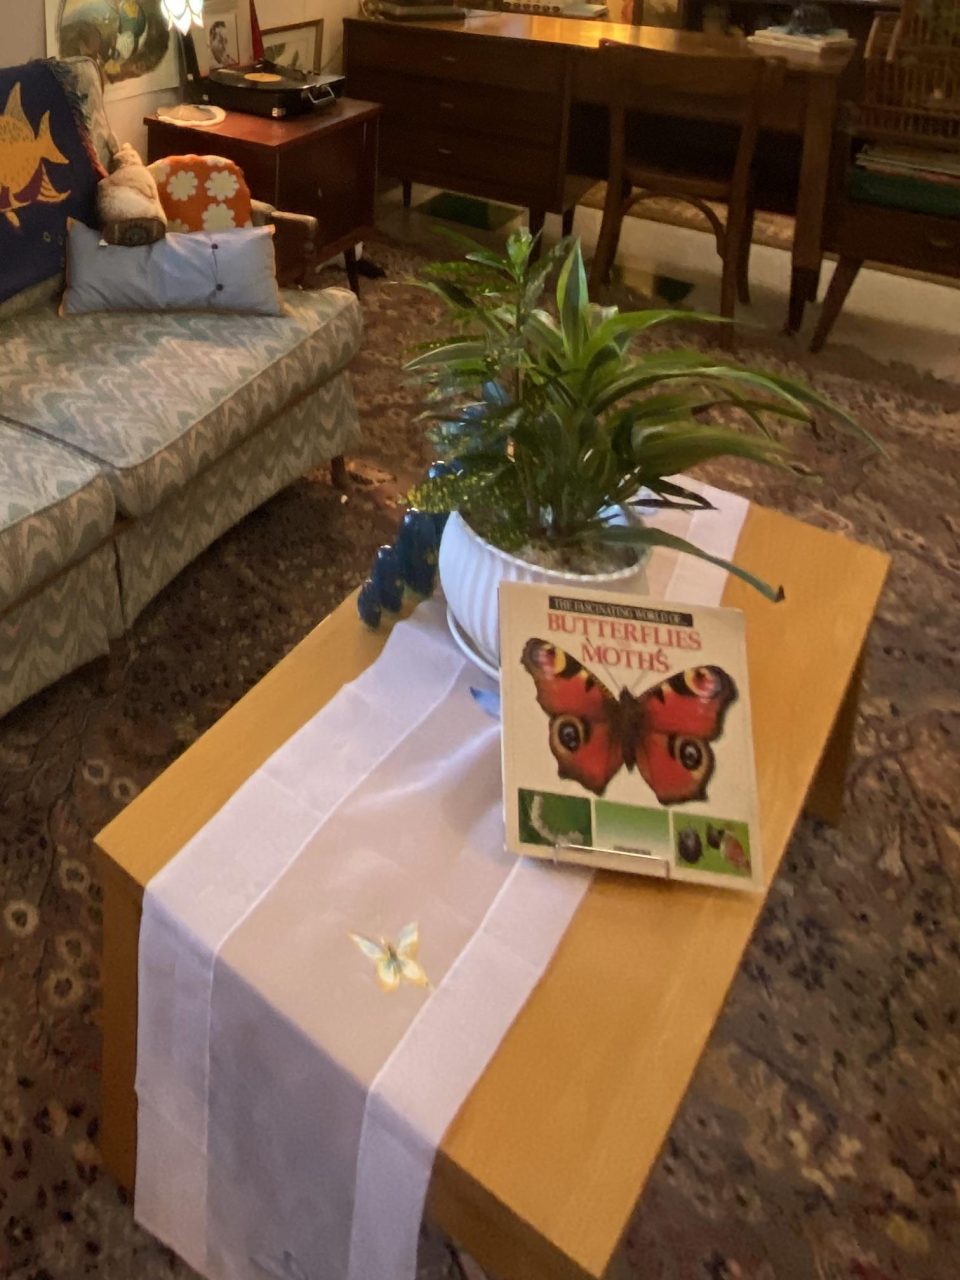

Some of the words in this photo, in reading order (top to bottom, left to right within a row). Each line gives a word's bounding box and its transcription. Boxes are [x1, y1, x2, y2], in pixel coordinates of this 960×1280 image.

[554, 598, 572, 610] THE
[574, 601, 634, 618] FASCINATING
[635, 608, 668, 621] WORLD
[547, 613, 702, 650] BUTTERFLIES
[581, 643, 670, 673] MOTHS
